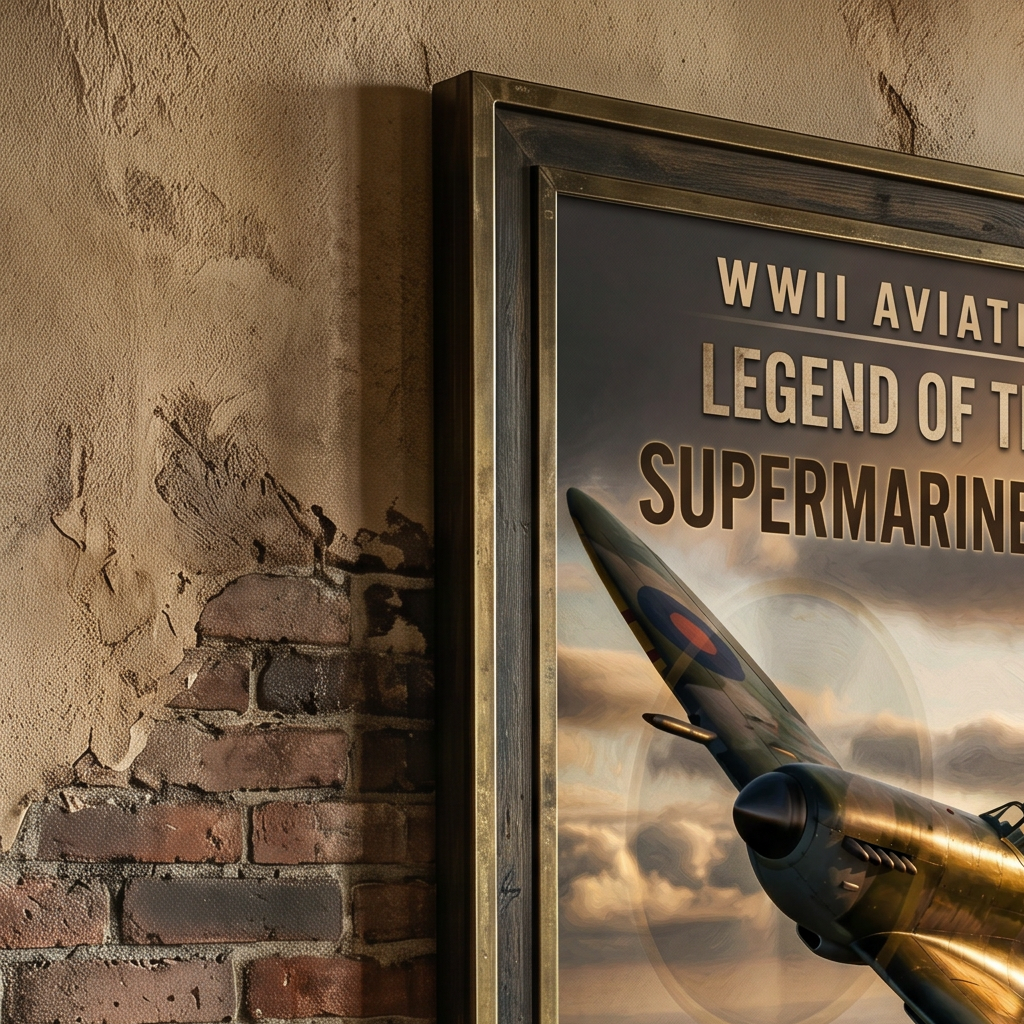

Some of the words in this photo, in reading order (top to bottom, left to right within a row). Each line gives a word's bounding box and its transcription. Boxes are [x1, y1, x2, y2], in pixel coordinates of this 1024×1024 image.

[717, 257, 847, 321] WWII
[702, 342, 899, 436] LEGEND
[917, 372, 976, 443] OF
